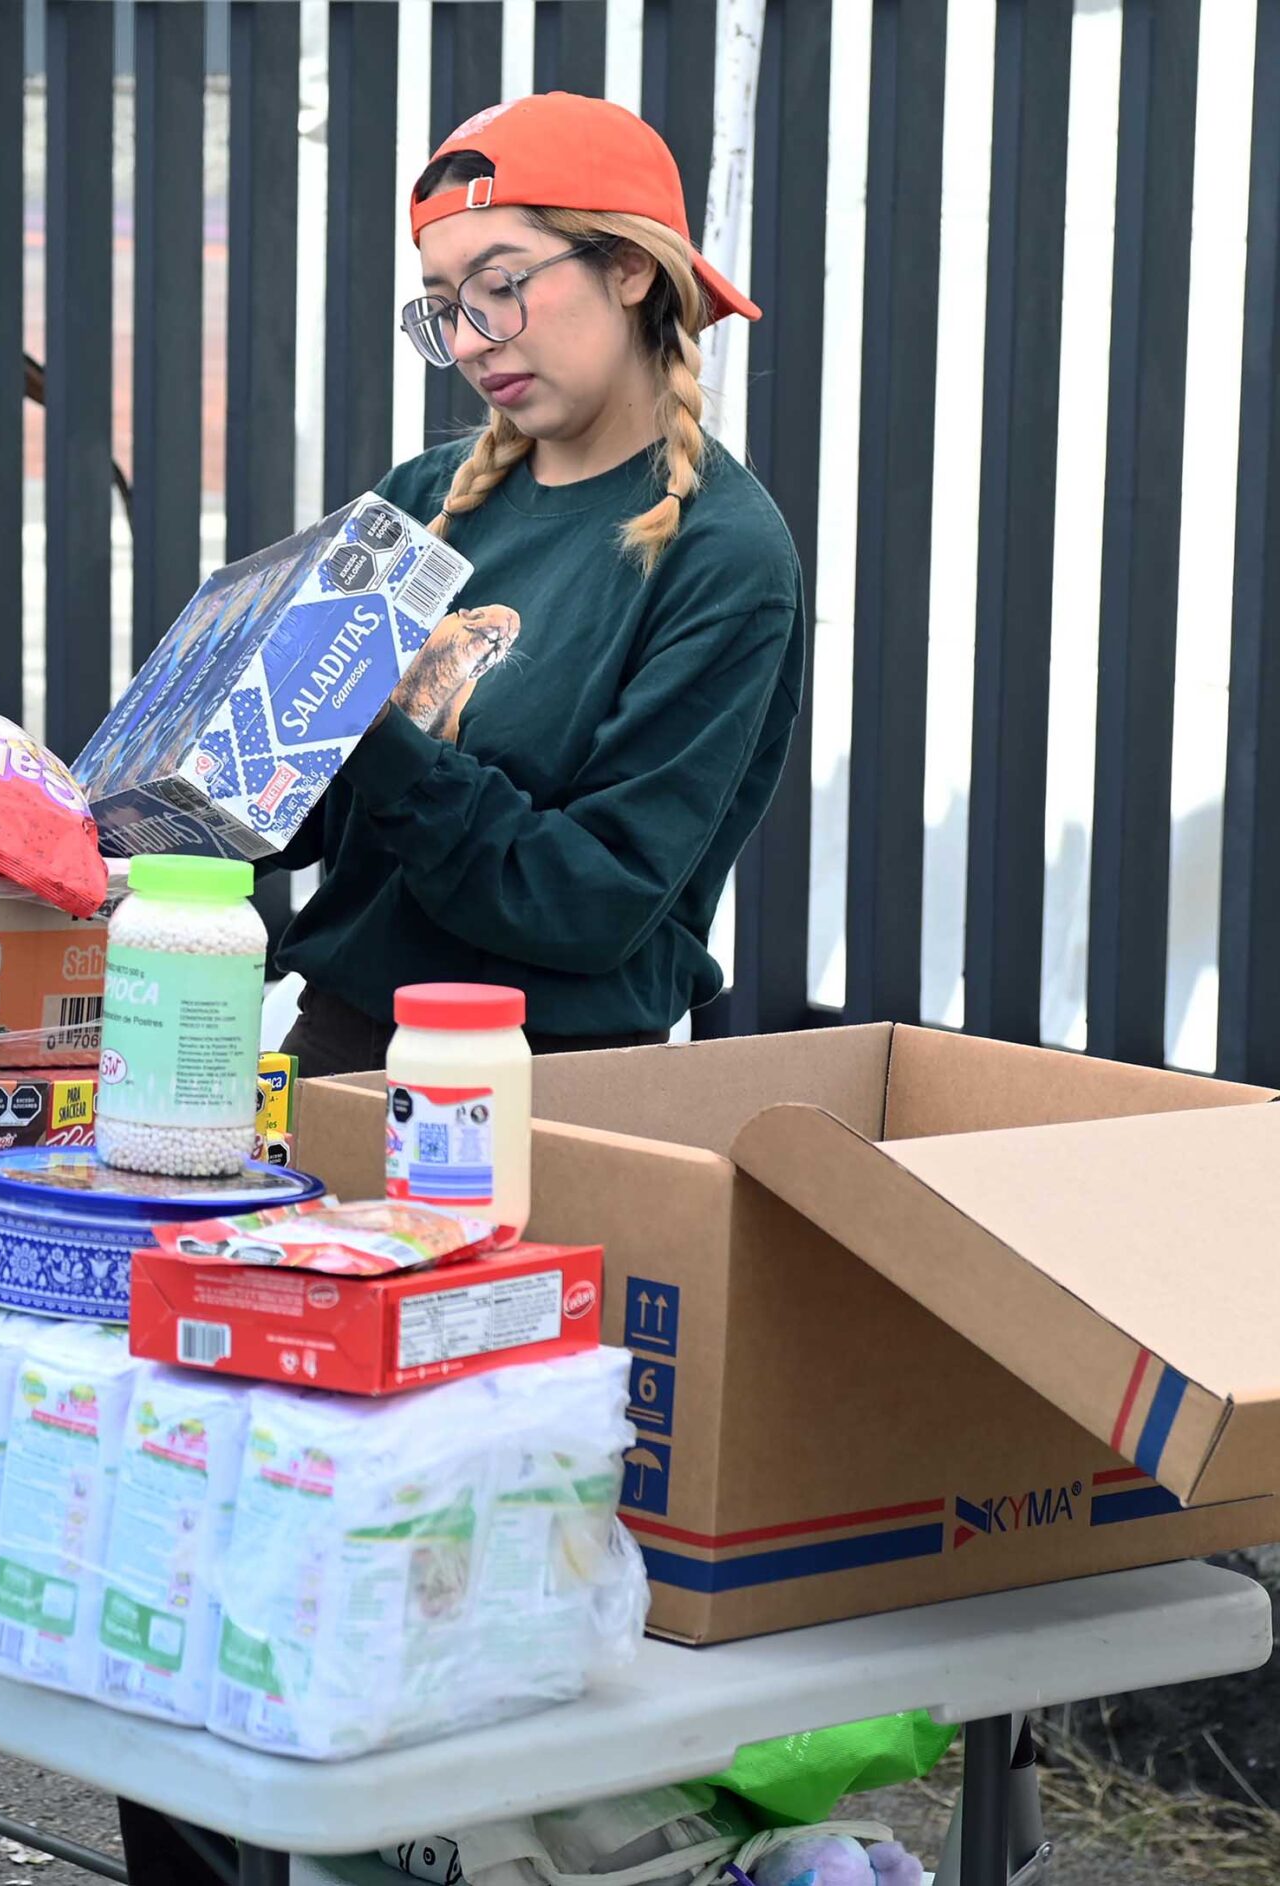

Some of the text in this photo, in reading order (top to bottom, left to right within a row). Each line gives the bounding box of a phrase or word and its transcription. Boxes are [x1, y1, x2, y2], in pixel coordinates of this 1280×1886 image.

[280, 603, 381, 738] SALADITAS
[331, 662, 372, 711] Gamesa
[247, 803, 271, 826] 8
[66, 1086, 81, 1104] PARA
[58, 1102, 87, 1123] SNACKEAR
[636, 1369, 658, 1403] 6
